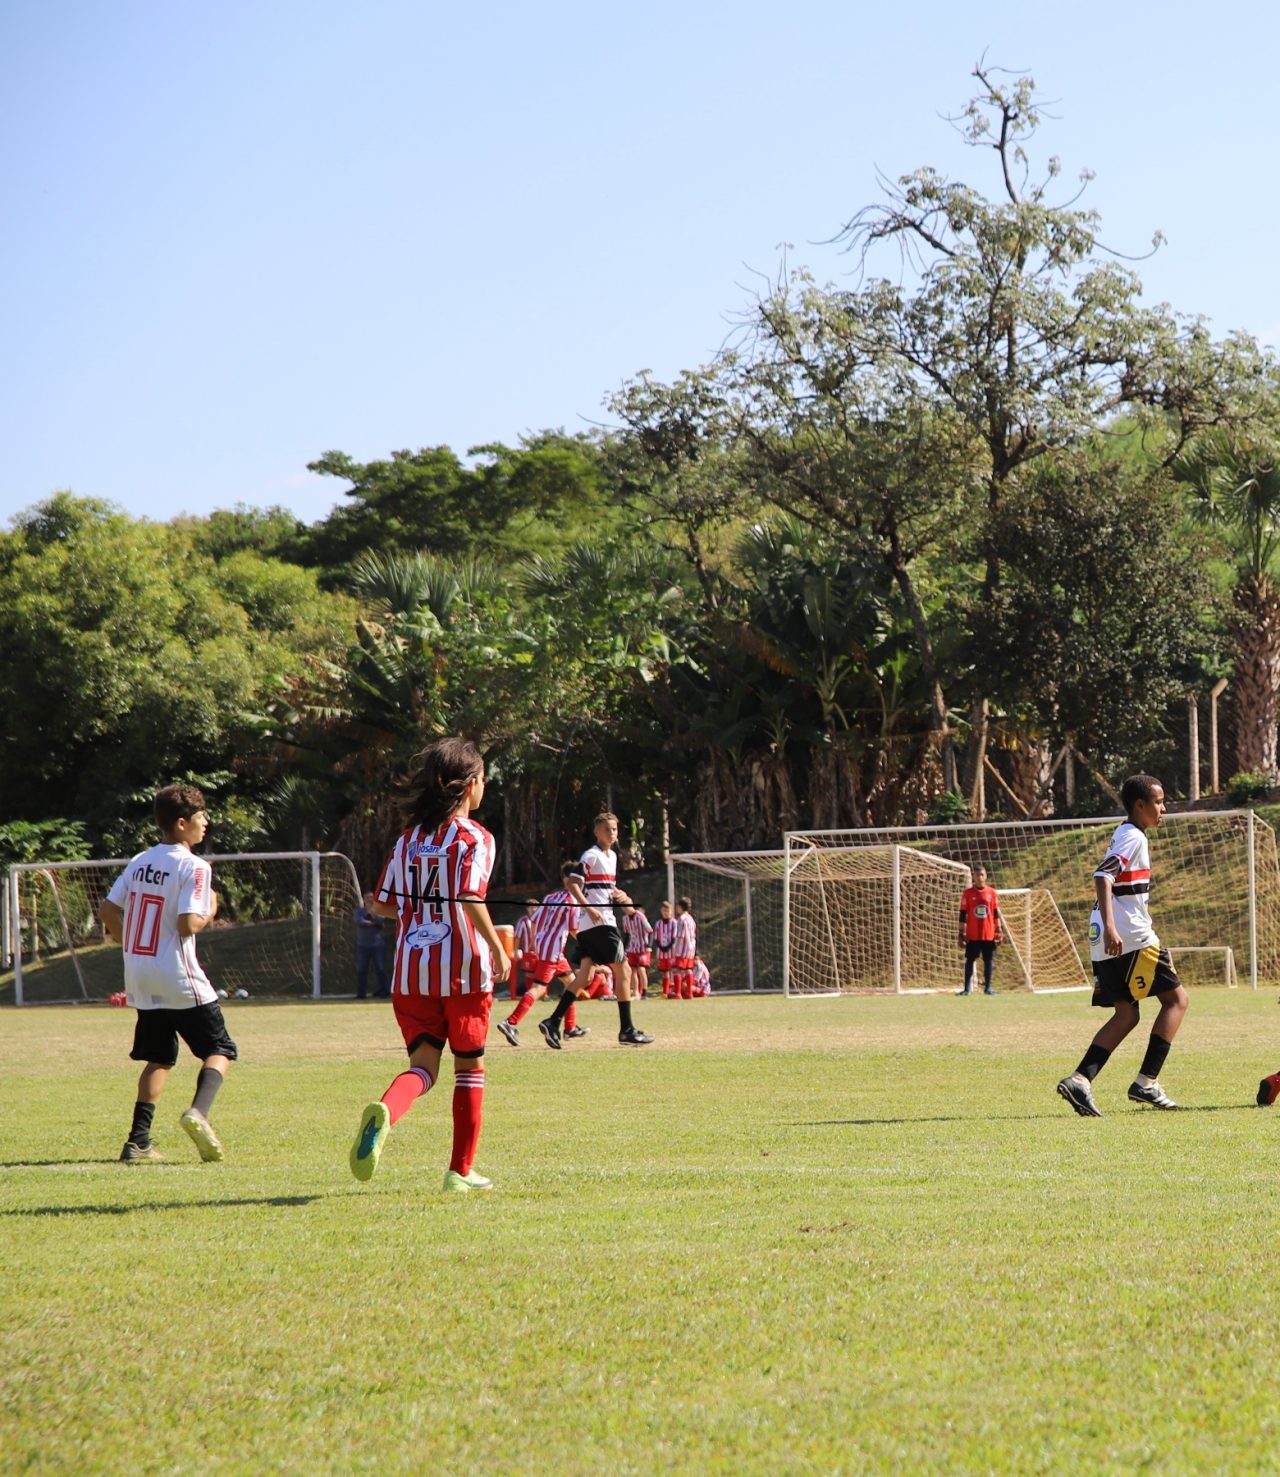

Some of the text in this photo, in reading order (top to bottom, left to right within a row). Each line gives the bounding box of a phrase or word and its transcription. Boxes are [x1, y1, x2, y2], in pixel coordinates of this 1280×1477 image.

[409, 865, 444, 914] 14
[125, 892, 165, 957] 10
[1135, 976, 1146, 989] 3
